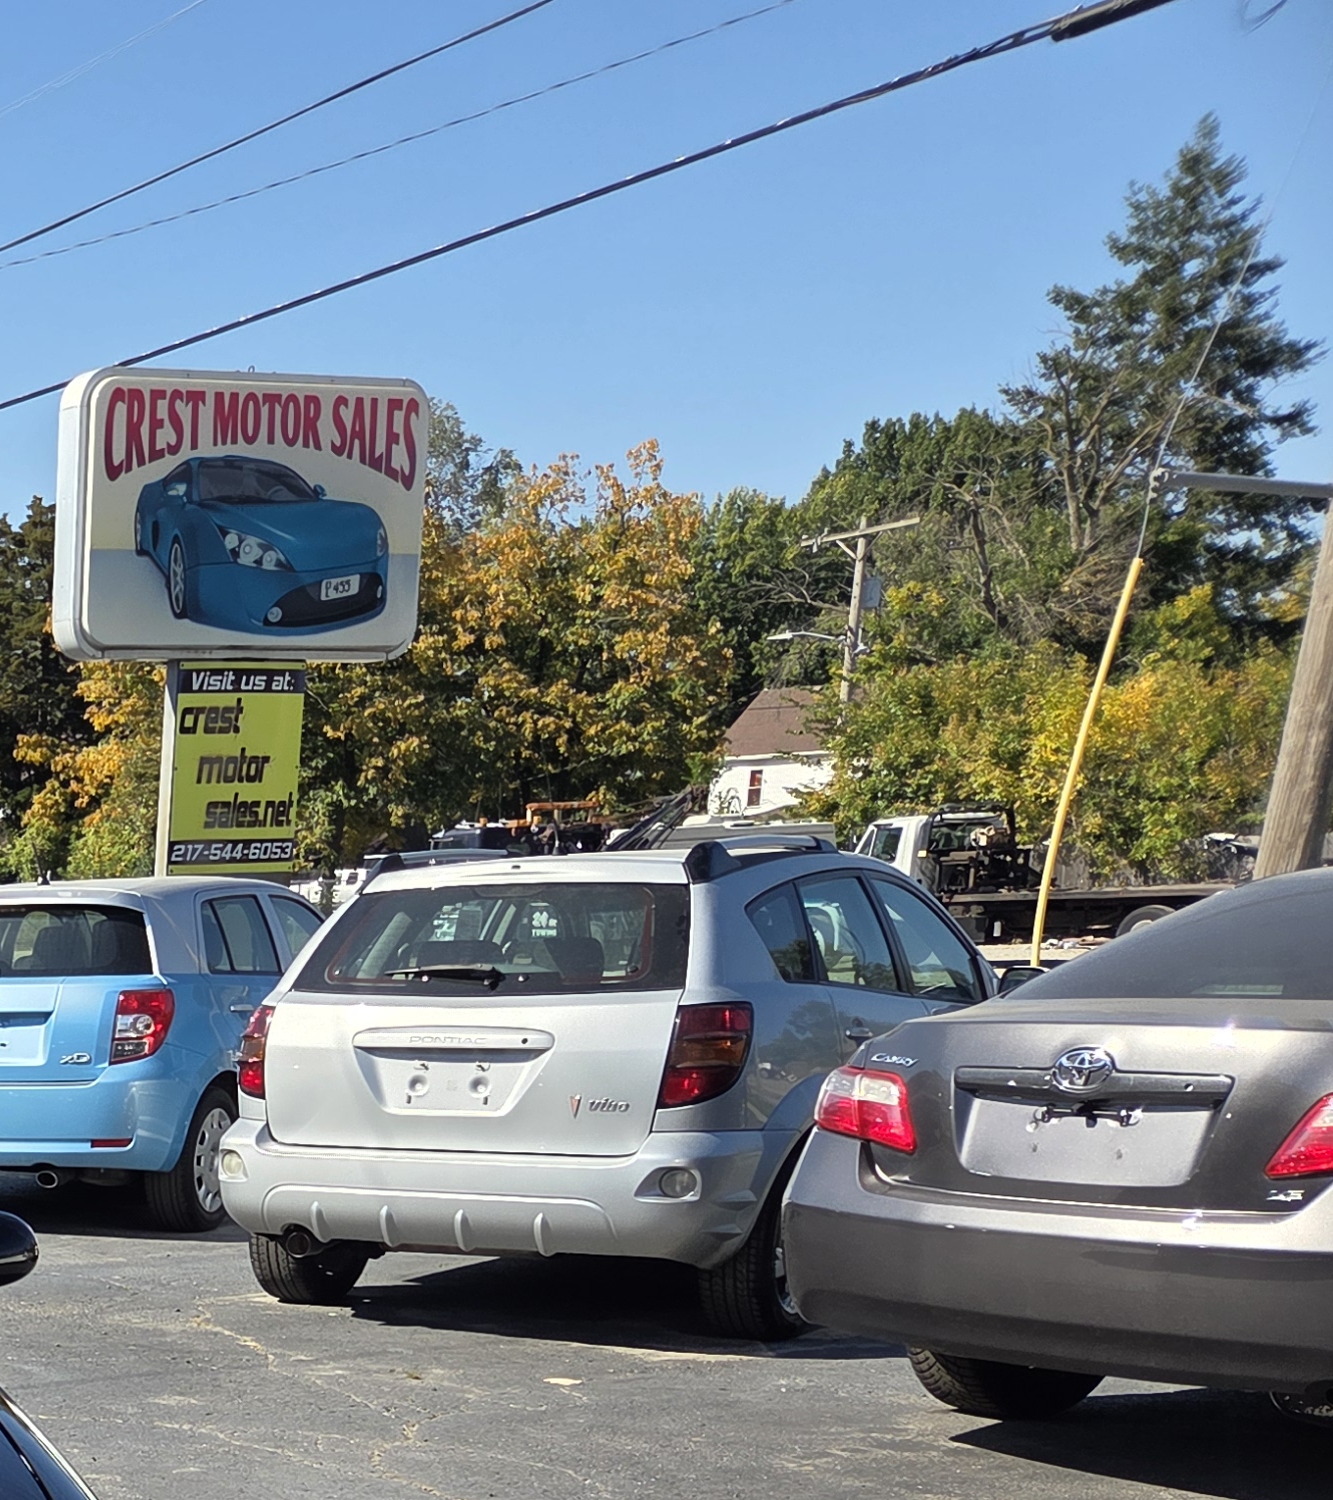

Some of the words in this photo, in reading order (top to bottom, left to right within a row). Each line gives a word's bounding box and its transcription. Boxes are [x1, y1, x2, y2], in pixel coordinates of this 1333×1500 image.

[104, 387, 206, 481] CREST
[213, 391, 322, 451] MOTOR
[331, 394, 420, 491] SALES
[191, 671, 235, 690] Visit
[240, 675, 267, 690] us
[271, 671, 295, 691] at:
[179, 697, 244, 735] crest
[196, 747, 271, 784] motor
[203, 792, 294, 829] sales.net
[171, 842, 293, 861] 217-544-6053
[409, 1036, 488, 1045] PONTIAC
